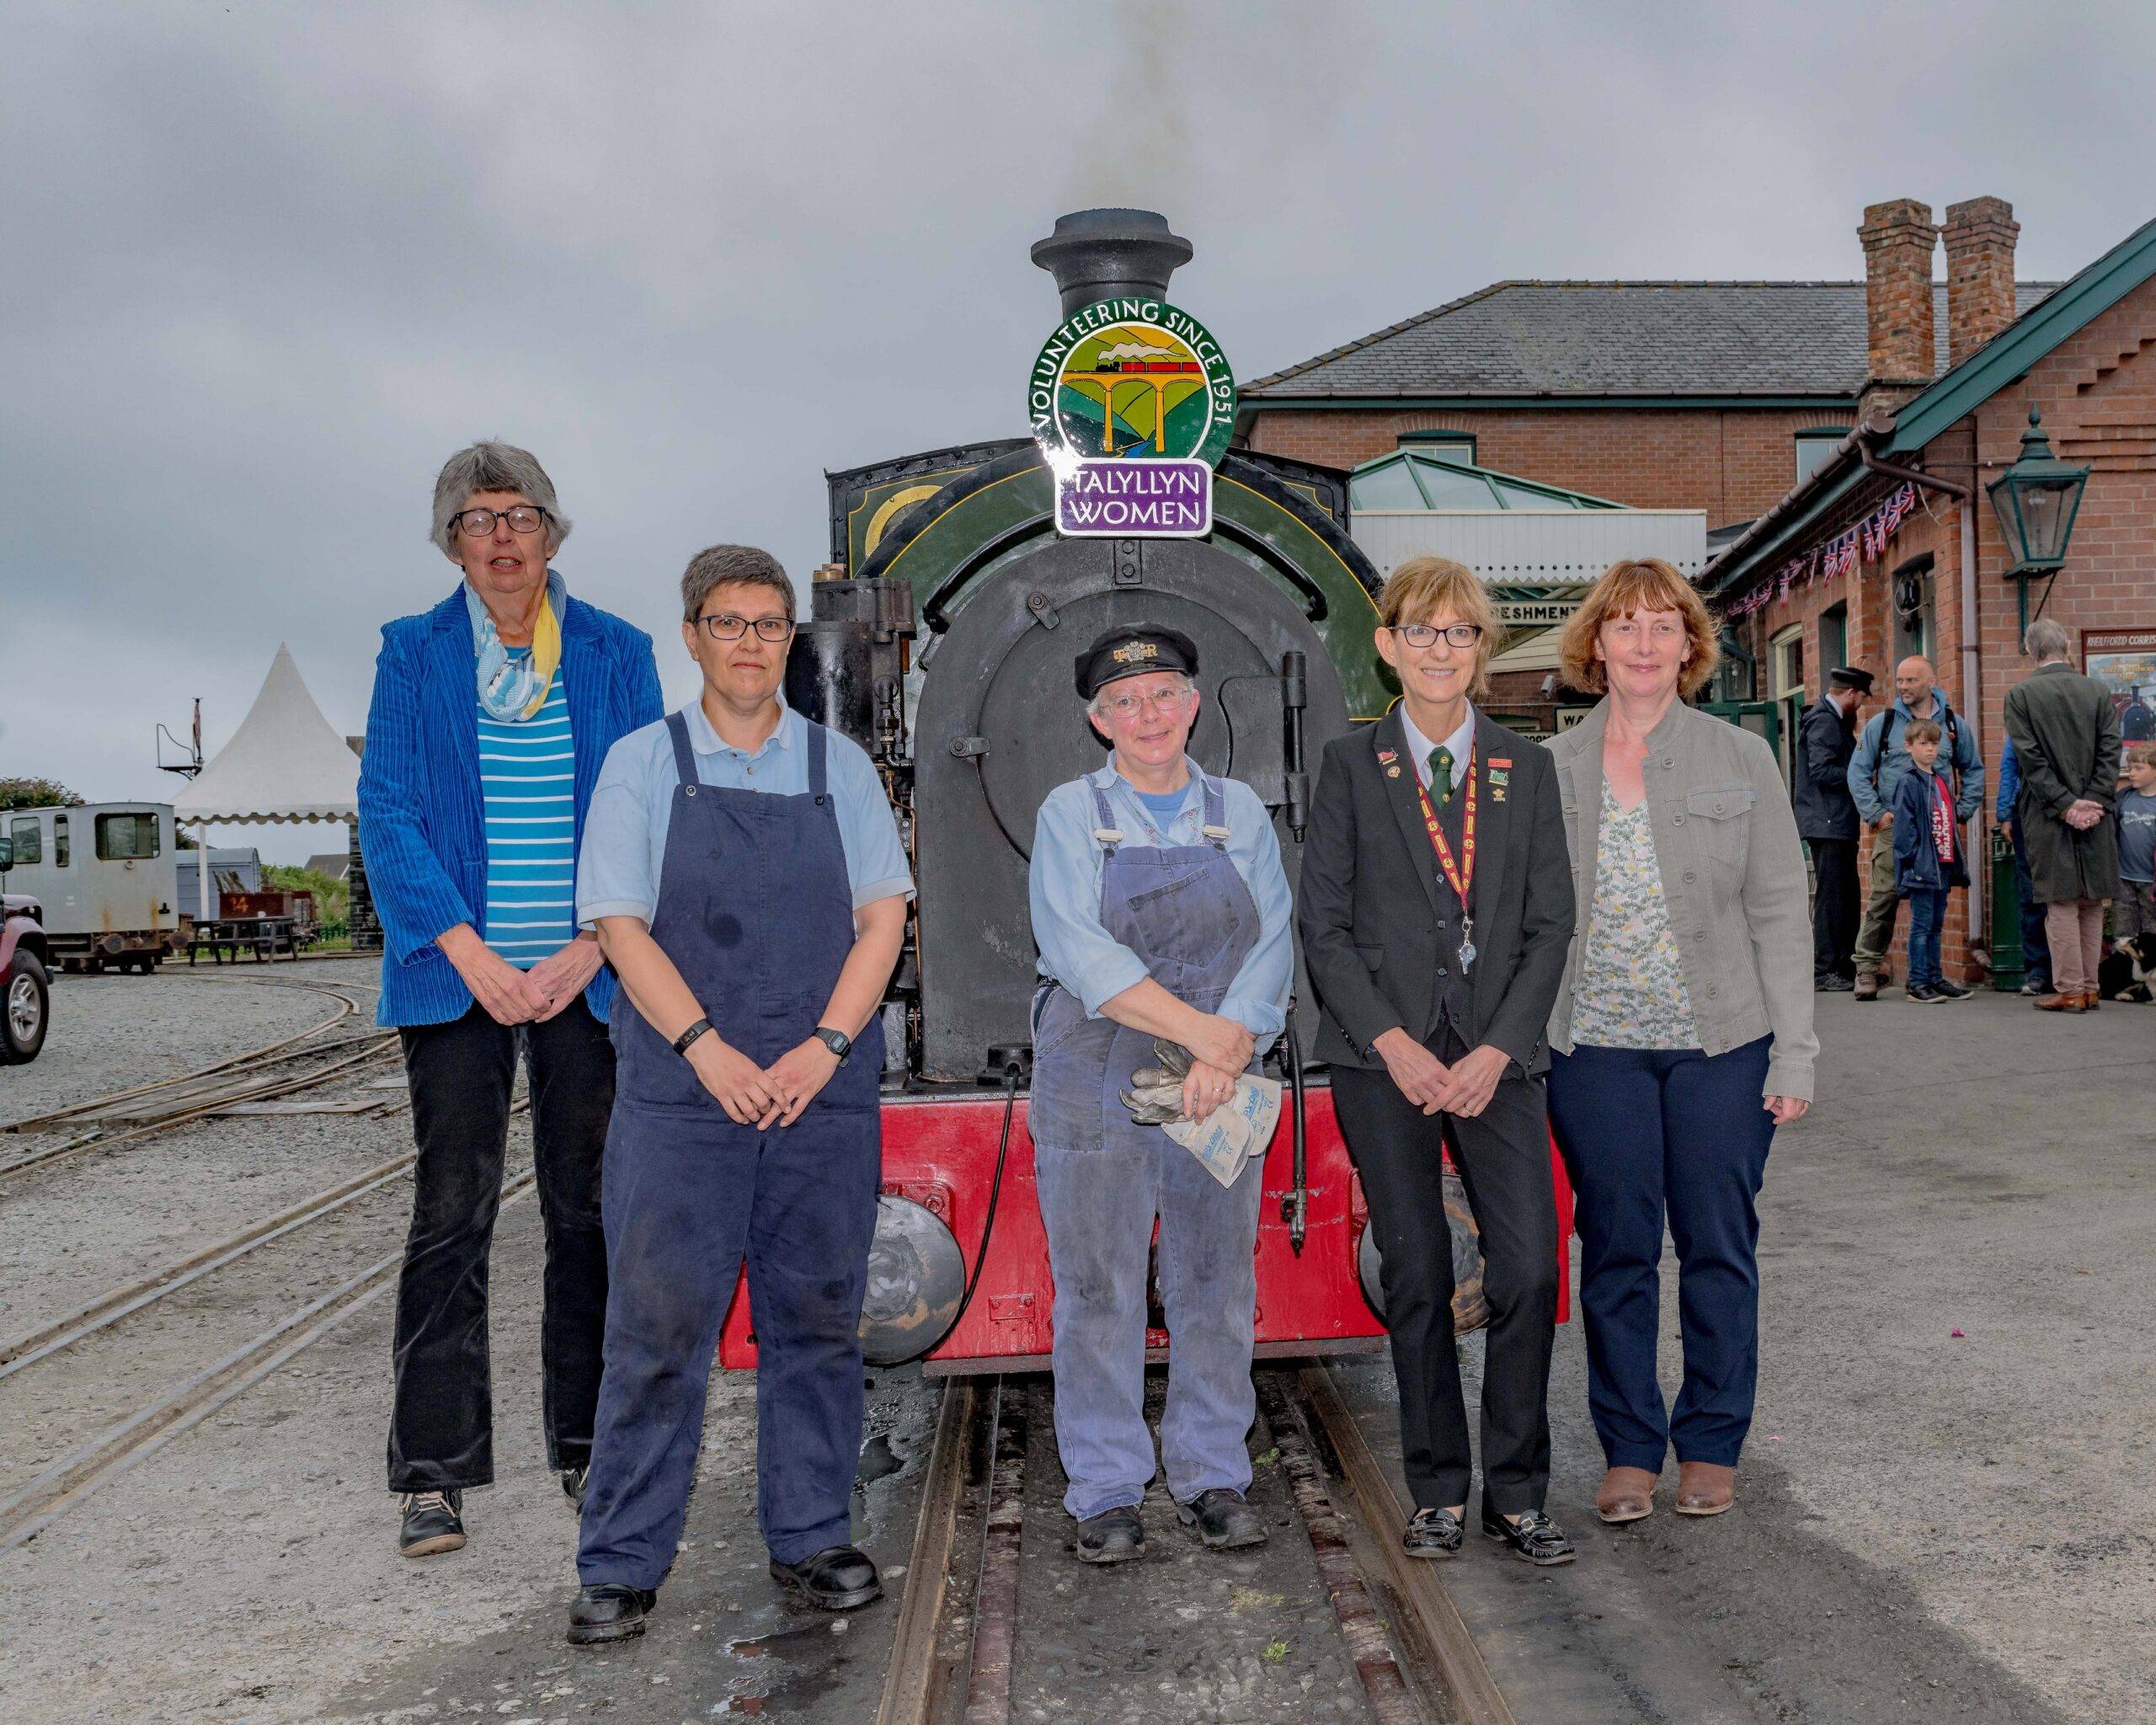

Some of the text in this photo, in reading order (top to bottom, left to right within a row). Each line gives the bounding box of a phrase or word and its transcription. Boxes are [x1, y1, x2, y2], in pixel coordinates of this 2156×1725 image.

[1032, 299, 1233, 430] VOLUNTEERING SINCE 1951
[1073, 469, 1200, 495] TALYLLYN
[1069, 500, 1200, 525] WOMEN
[1524, 735, 1550, 744] OOM
